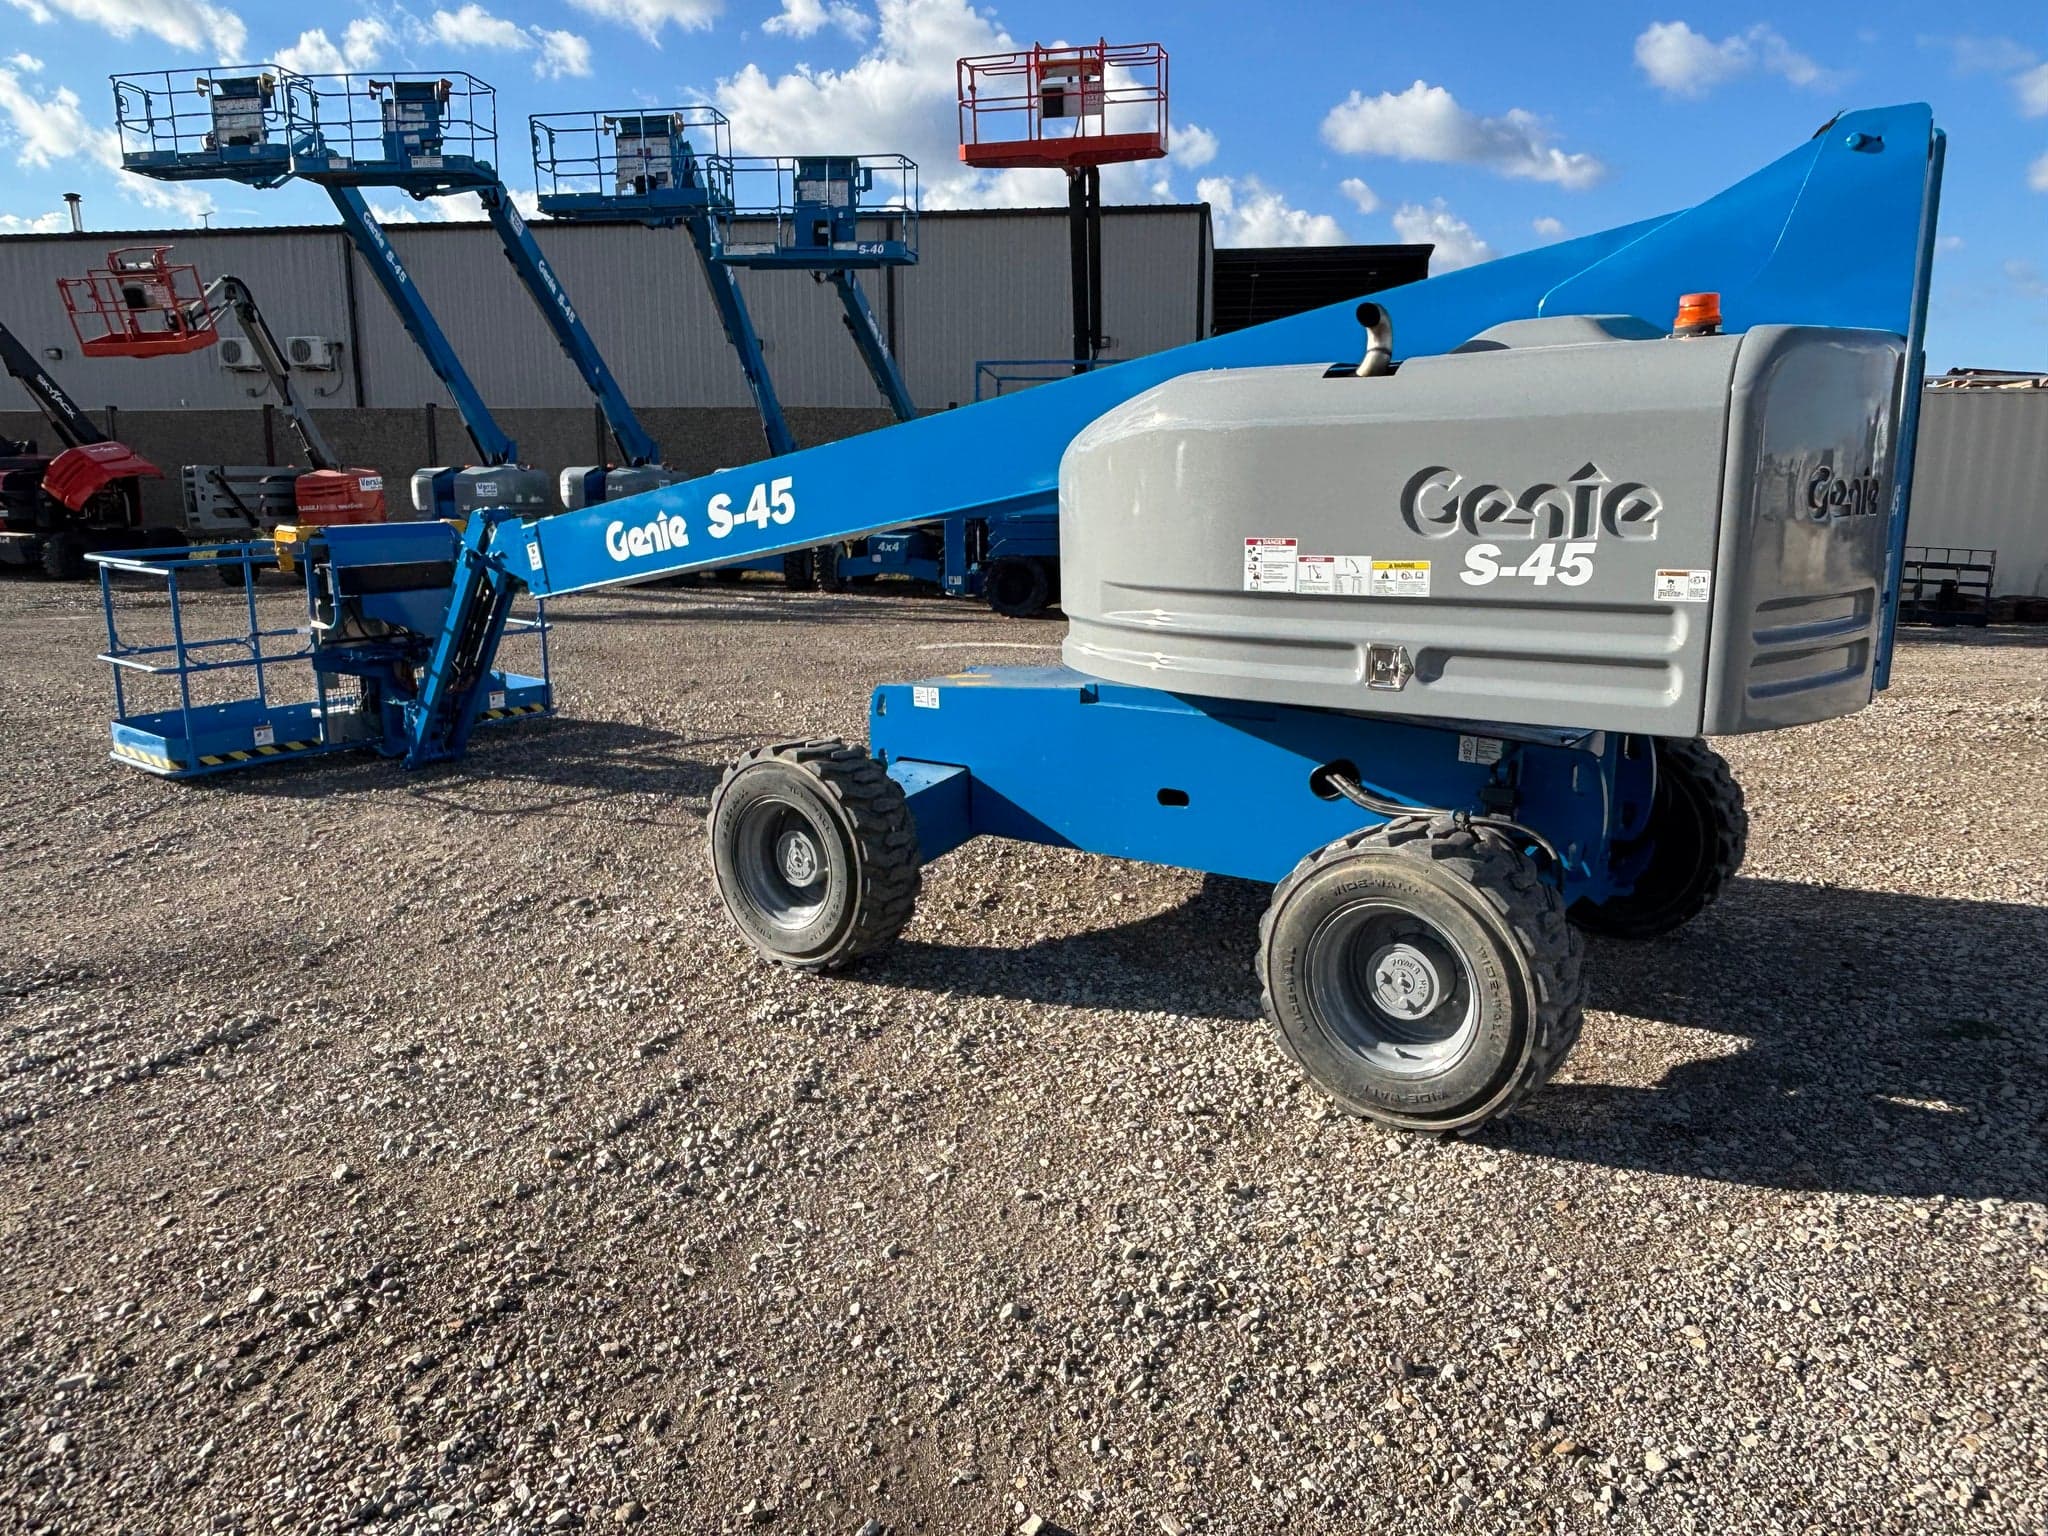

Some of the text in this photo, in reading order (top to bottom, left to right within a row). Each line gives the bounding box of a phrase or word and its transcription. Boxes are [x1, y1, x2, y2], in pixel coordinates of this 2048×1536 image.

[386, 250, 407, 283] S-45
[858, 243, 885, 255] S-40
[1400, 462, 1663, 541] Genie
[1807, 465, 1880, 522] Genie
[605, 509, 690, 562] Genie
[706, 476, 796, 539] S-45
[877, 541, 900, 552] 4x4
[1459, 542, 1598, 587] S-45
